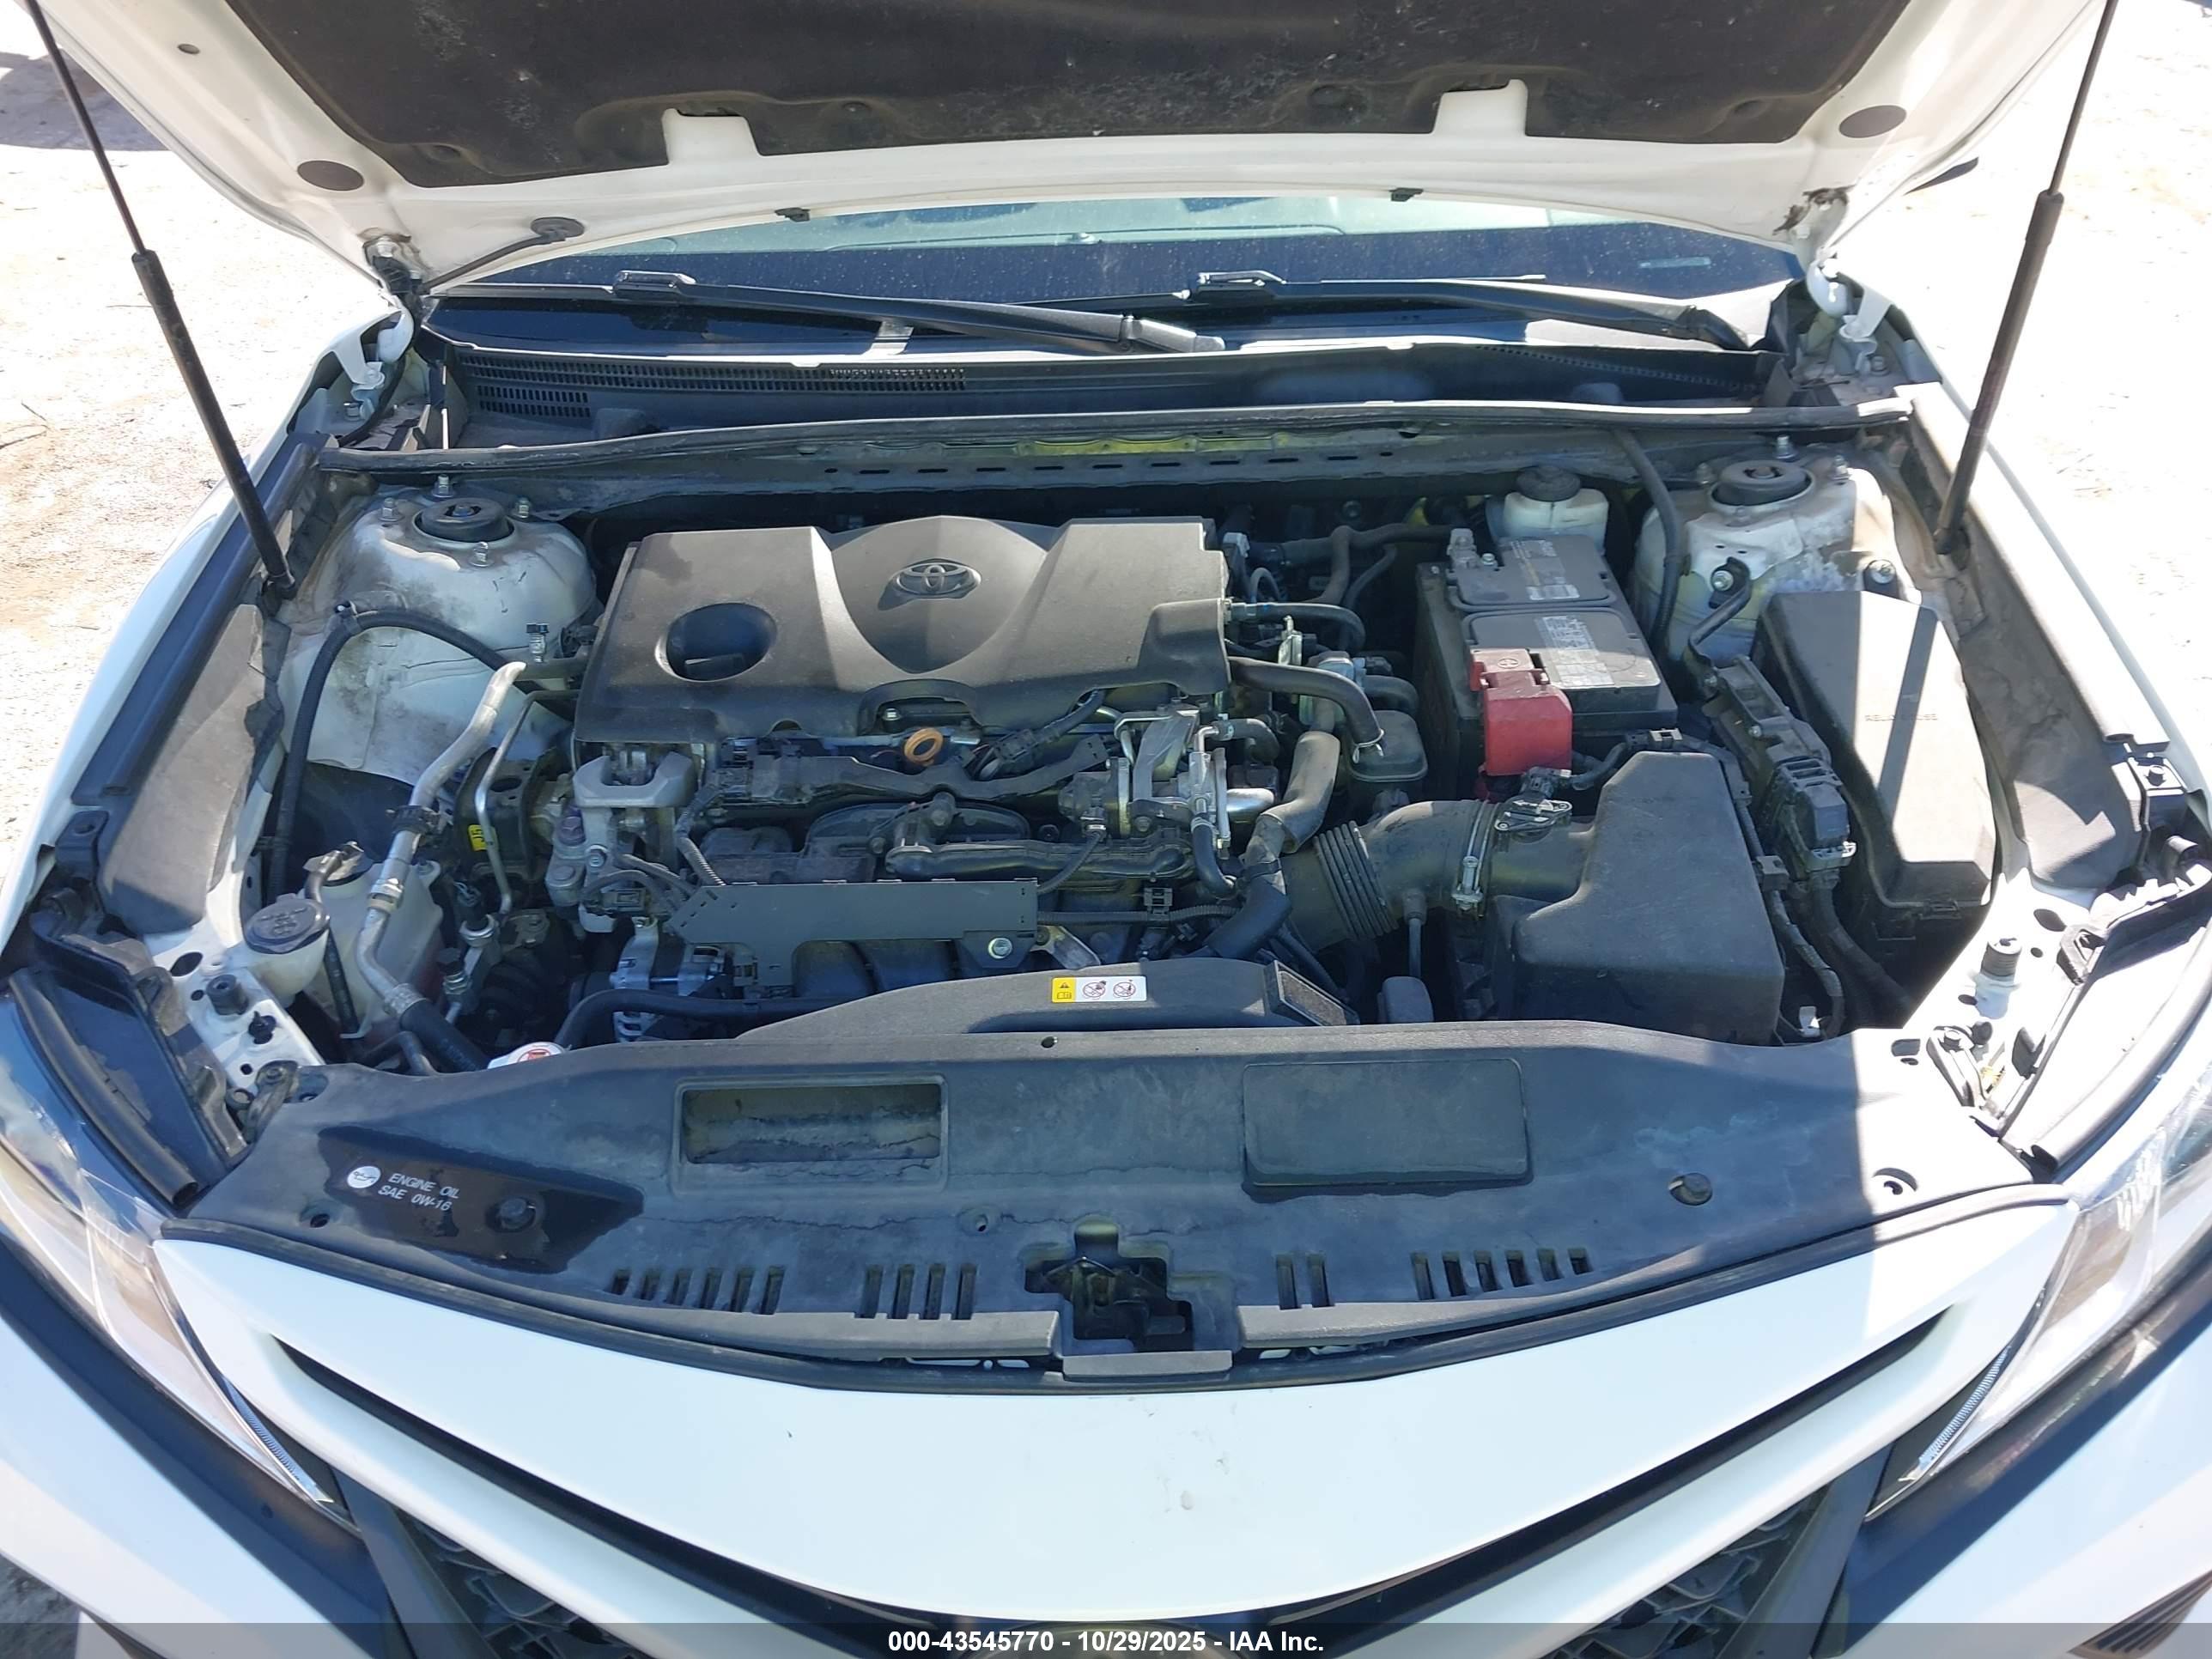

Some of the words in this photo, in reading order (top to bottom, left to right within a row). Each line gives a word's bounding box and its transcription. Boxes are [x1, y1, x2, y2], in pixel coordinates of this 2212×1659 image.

[378, 1185, 408, 1200] SAE
[411, 1194, 453, 1212] 0W-16
[388, 1173, 437, 1192] ENGINE
[440, 1186, 460, 1200] OIL
